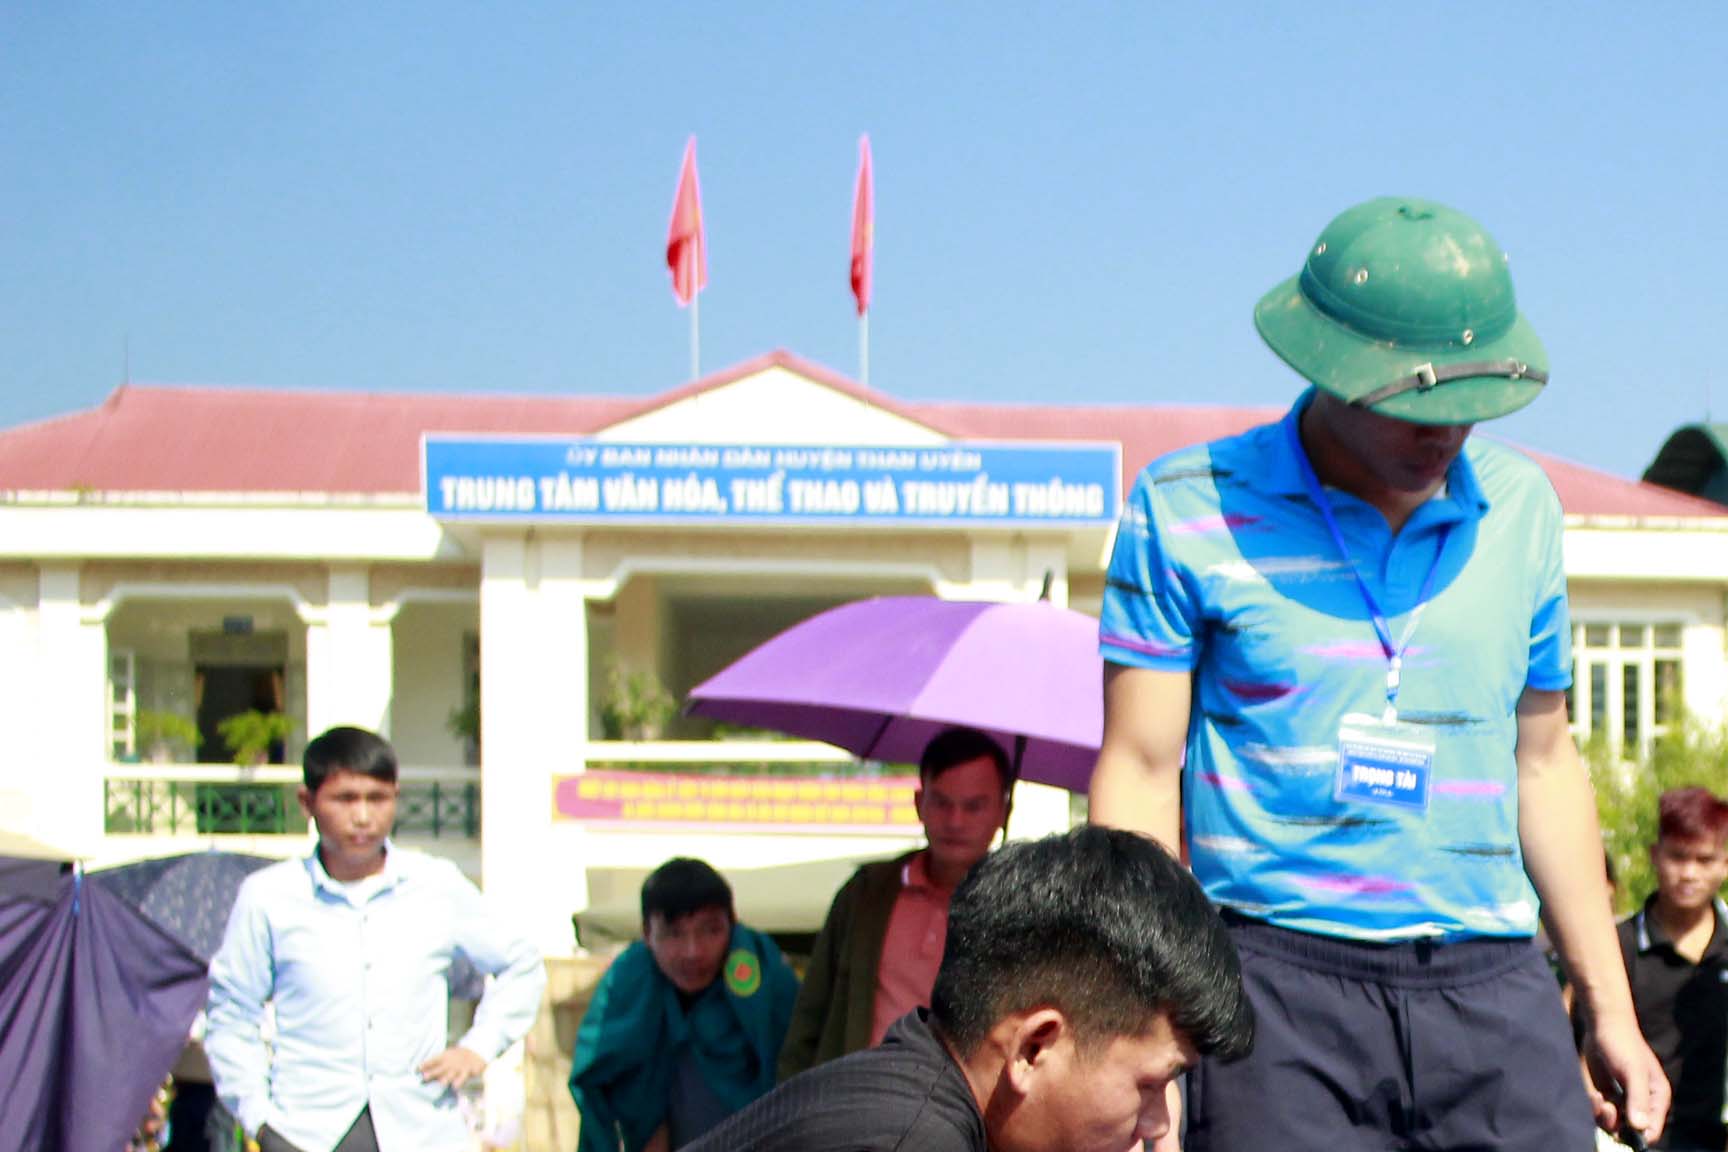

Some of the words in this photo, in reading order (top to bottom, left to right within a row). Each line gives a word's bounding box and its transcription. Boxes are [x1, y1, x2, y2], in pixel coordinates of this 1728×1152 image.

[440, 475, 537, 512] TRUNG
[539, 469, 599, 512] TÂM
[602, 471, 659, 513] VĂN
[788, 478, 861, 514] THAO
[862, 473, 899, 514] VÀ
[1012, 475, 1105, 517] THÔNG
